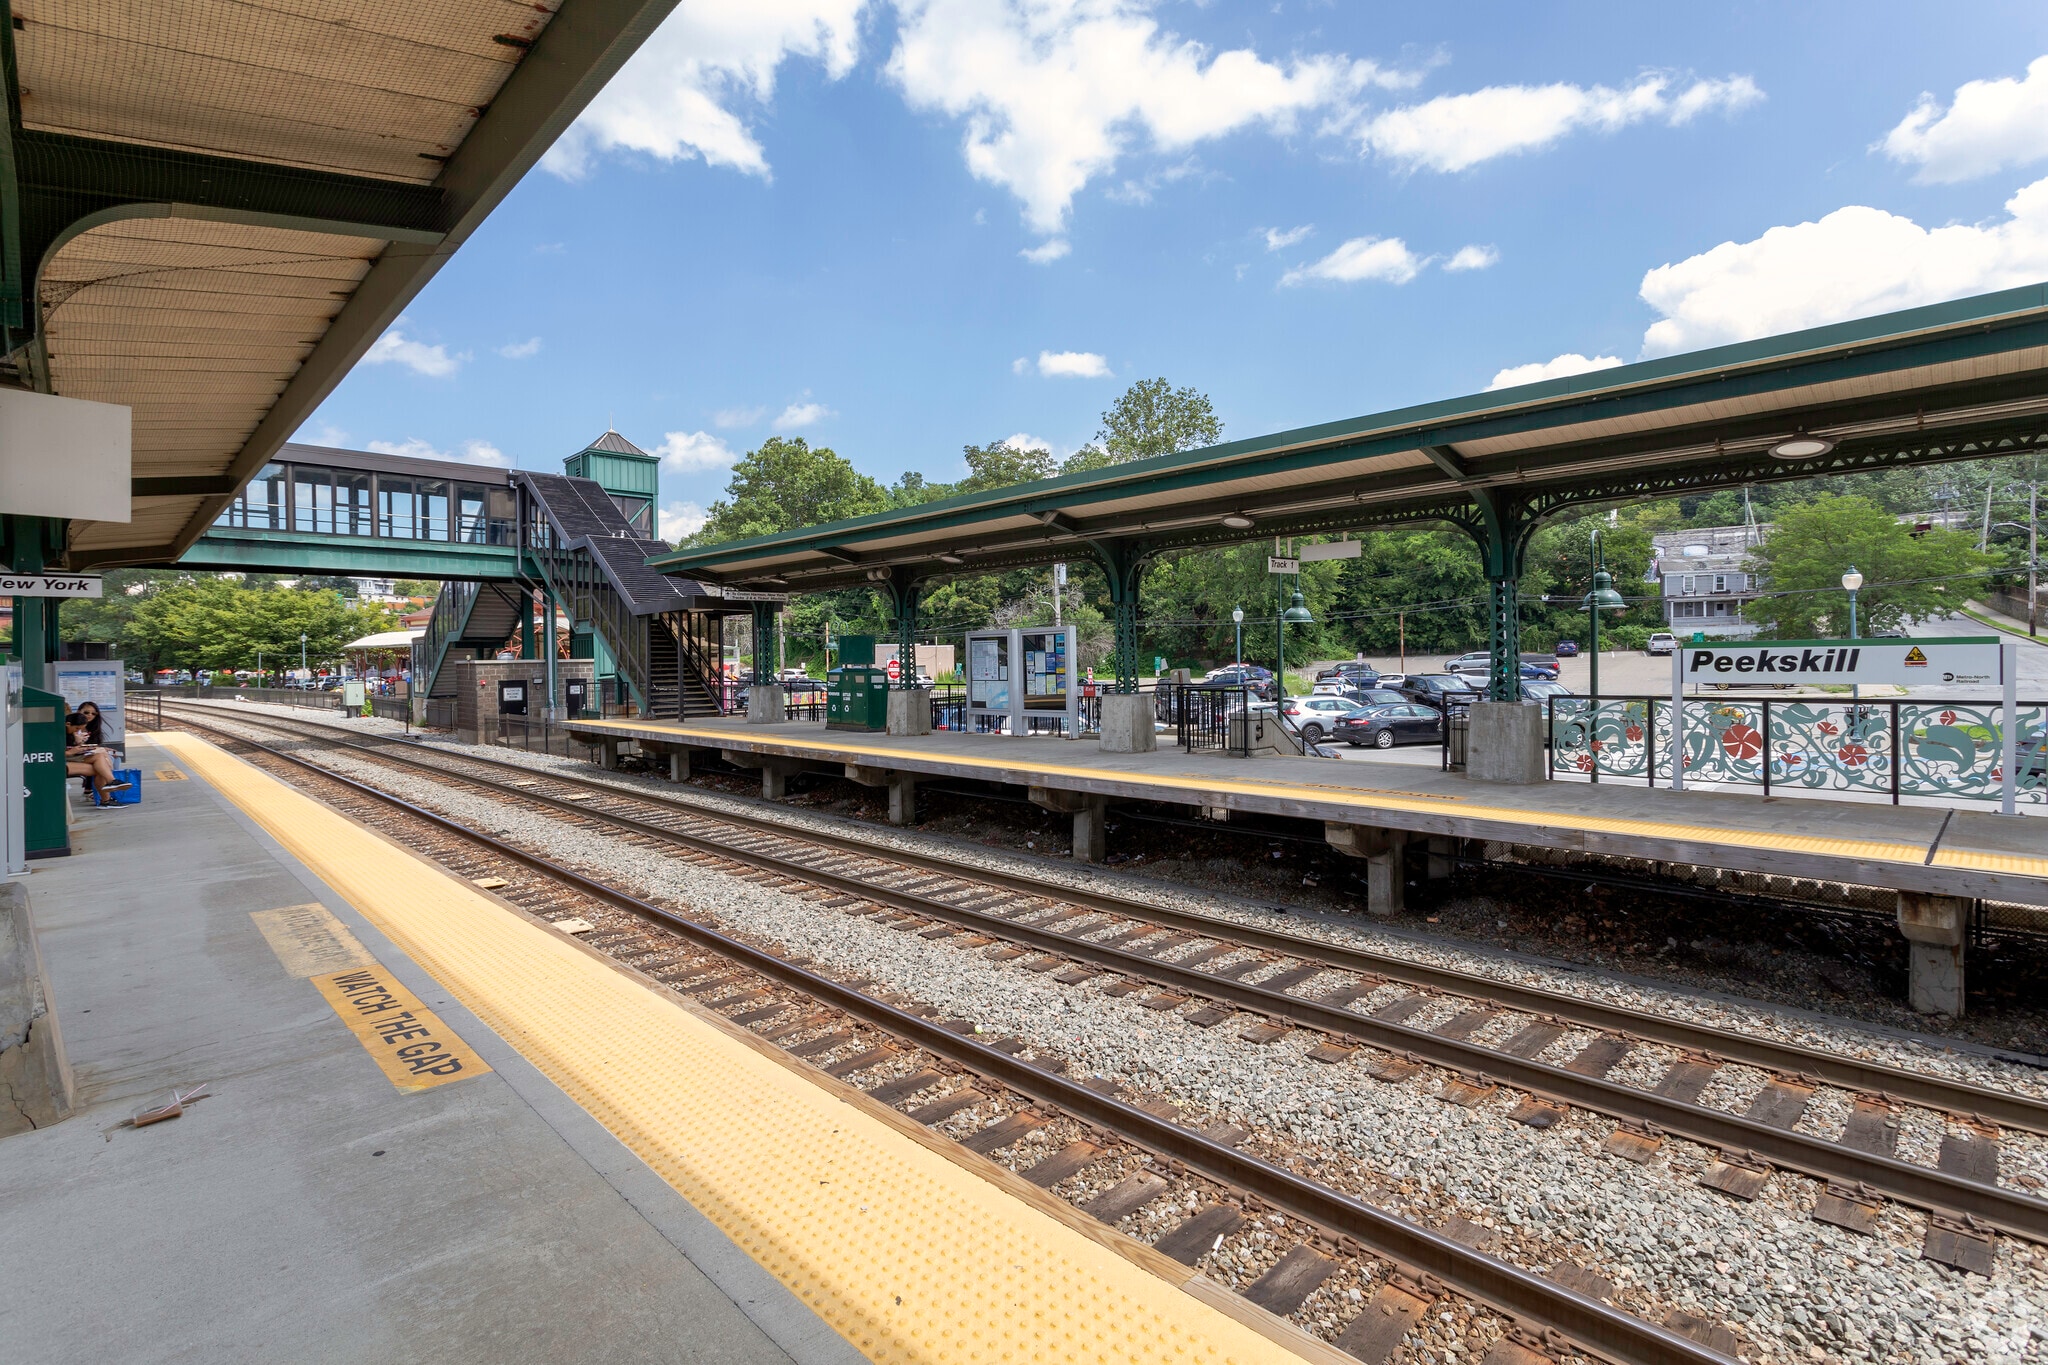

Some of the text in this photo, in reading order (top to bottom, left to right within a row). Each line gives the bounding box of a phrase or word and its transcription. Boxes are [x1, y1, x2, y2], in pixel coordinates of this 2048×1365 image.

[1271, 560, 1287, 568] Track
[0, 577, 90, 590] ew York
[1690, 648, 1861, 673] Peekskill
[23, 752, 54, 763] APER
[332, 970, 463, 1076] WATCH THE GAP
